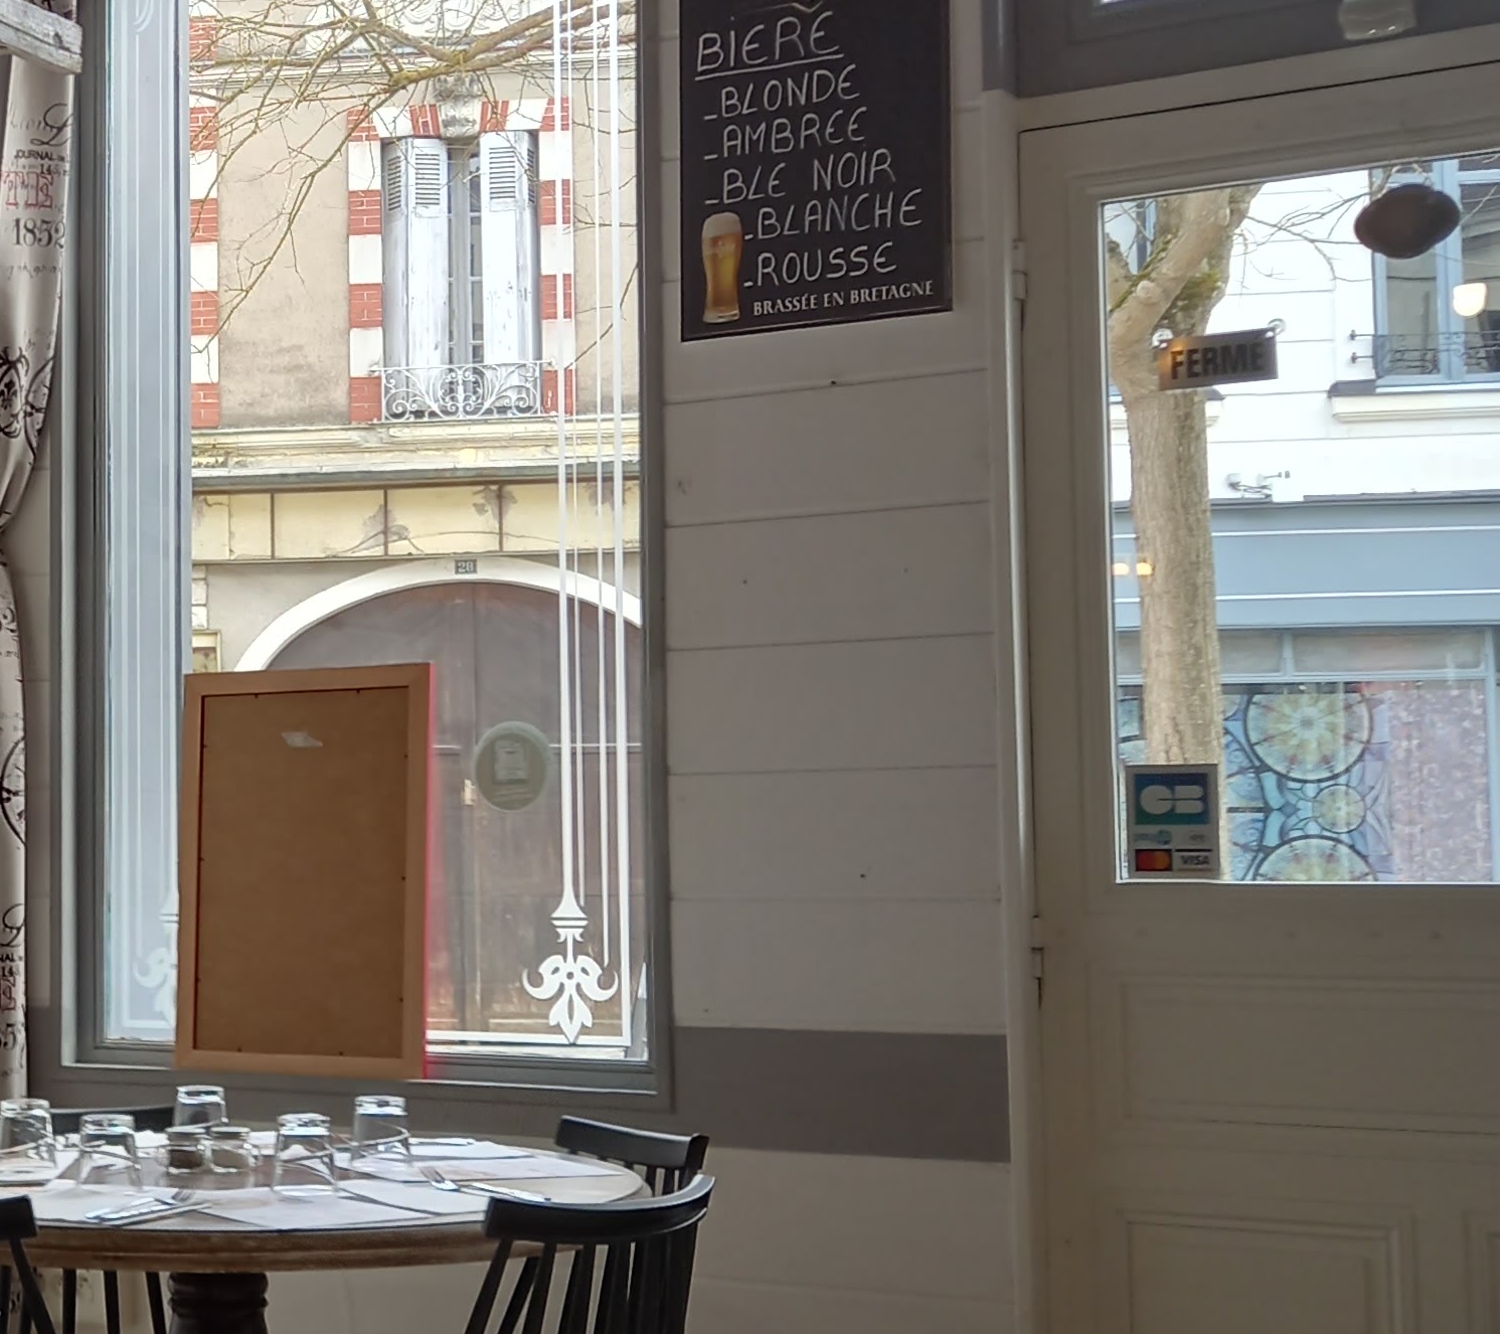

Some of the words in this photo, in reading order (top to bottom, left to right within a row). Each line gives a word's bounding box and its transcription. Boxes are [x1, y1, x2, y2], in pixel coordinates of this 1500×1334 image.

[14, 149, 55, 161] JOURNAL
[812, 148, 896, 191] NOIR
[13, 218, 65, 248] 1852
[823, 292, 844, 308] EN
[850, 280, 934, 305] BRETAGNE
[1181, 855, 1210, 866] VISA
